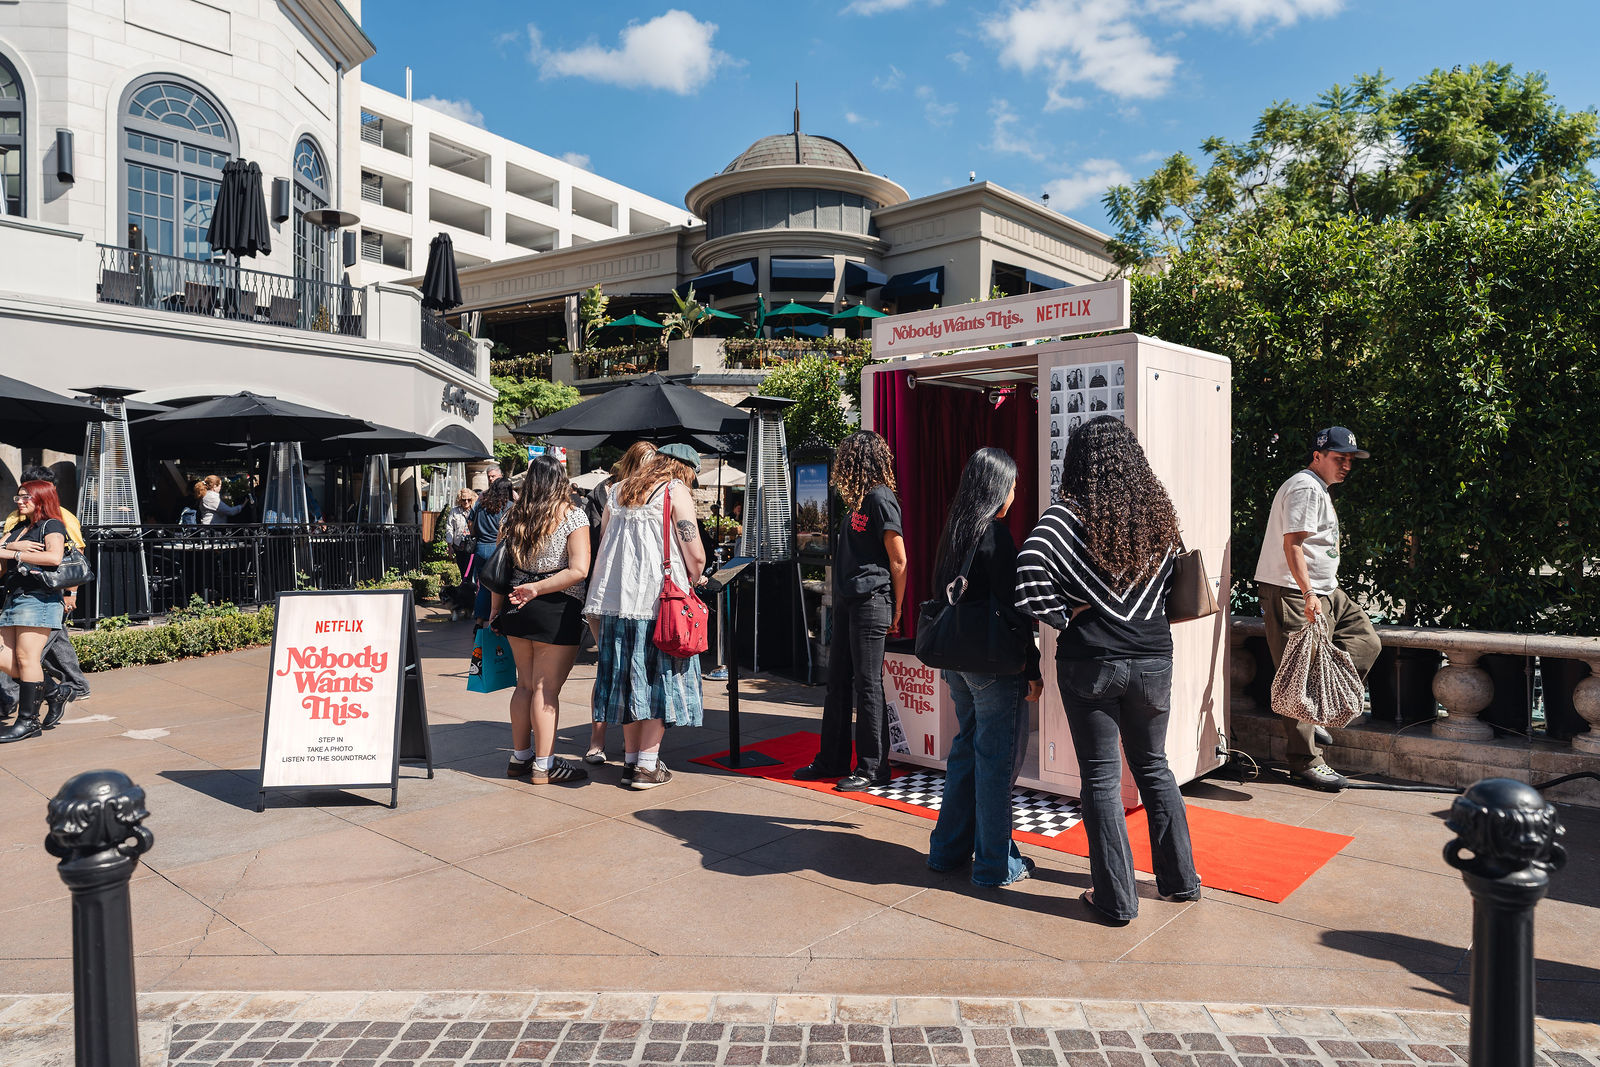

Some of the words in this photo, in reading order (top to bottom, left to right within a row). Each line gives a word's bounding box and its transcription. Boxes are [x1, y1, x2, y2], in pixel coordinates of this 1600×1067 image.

[888, 323, 942, 345] Nobody
[943, 316, 984, 333] Wants
[986, 309, 1023, 329] This.
[1036, 299, 1091, 323] NETFLIX
[315, 620, 363, 633] NETFLIX
[276, 645, 388, 676] Nobody
[883, 659, 934, 683] Nobody
[294, 670, 373, 693] Wants
[892, 676, 934, 695] Wants
[302, 696, 369, 725] This.
[899, 692, 934, 714] This.
[924, 734, 934, 755] N
